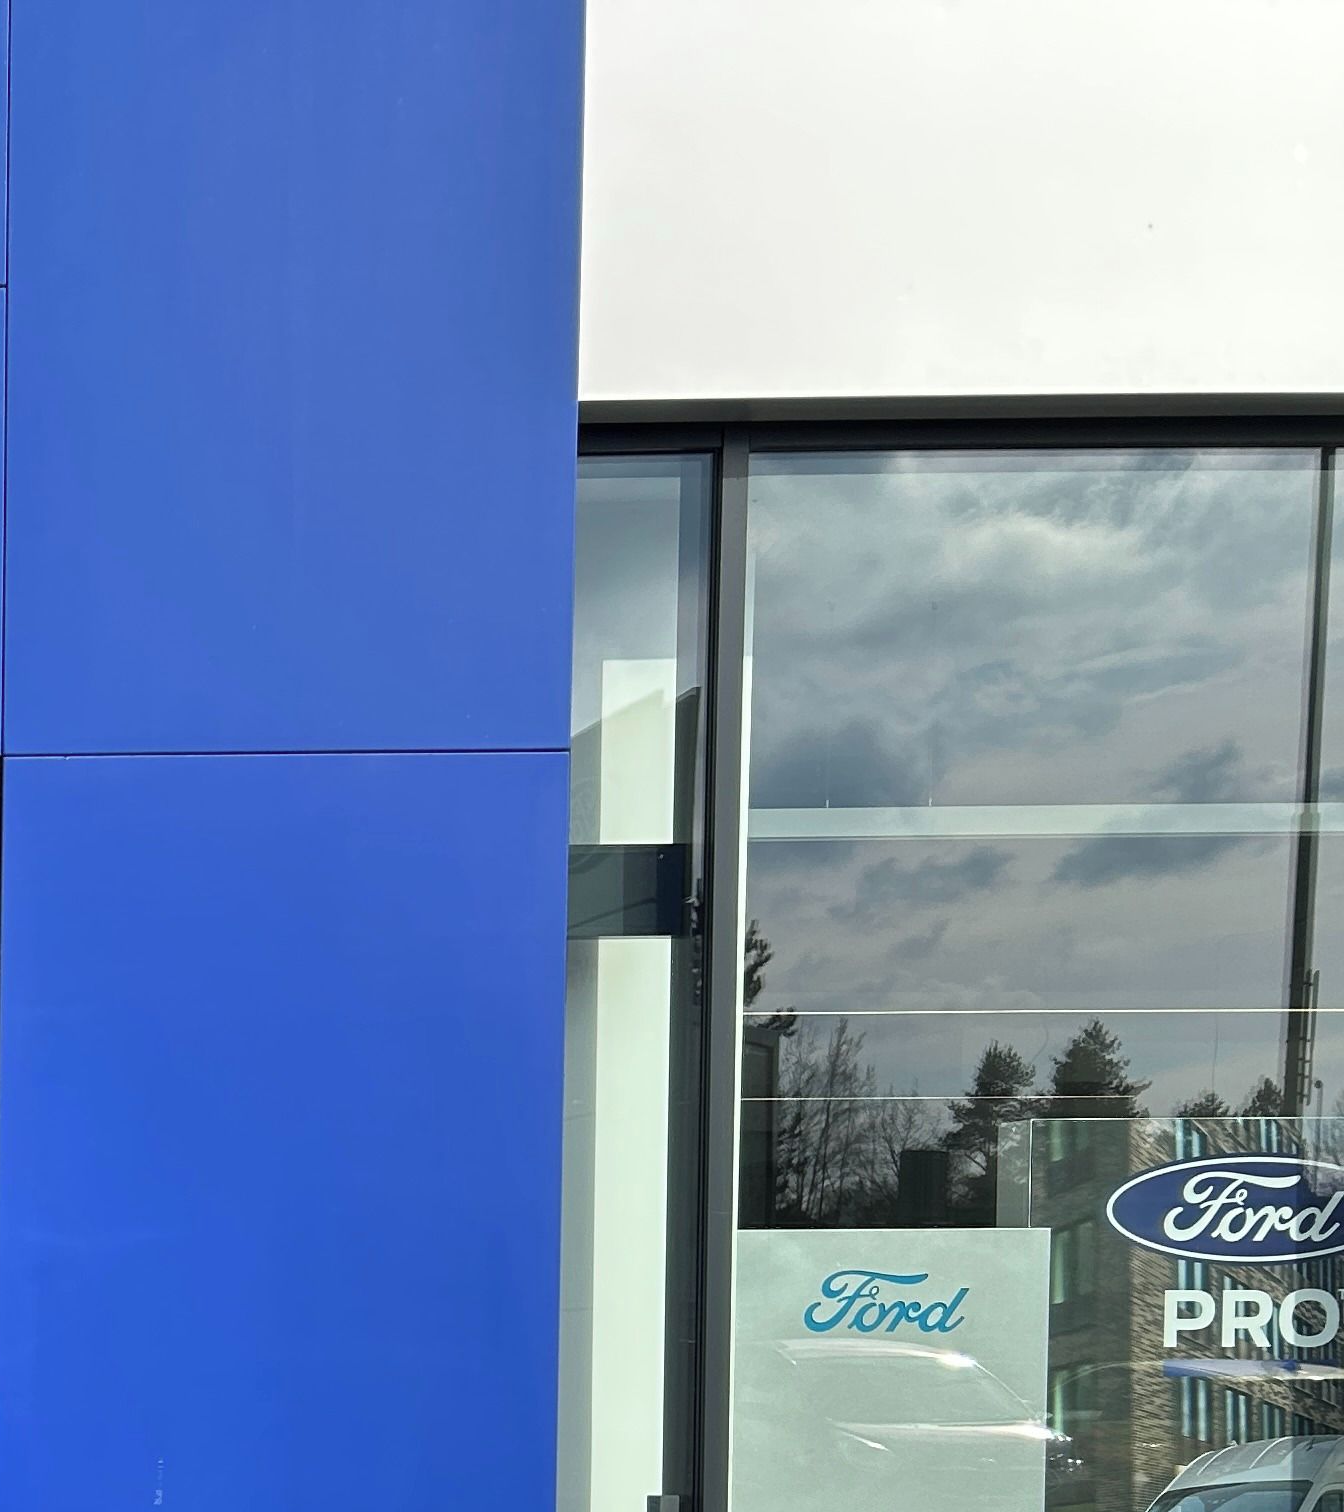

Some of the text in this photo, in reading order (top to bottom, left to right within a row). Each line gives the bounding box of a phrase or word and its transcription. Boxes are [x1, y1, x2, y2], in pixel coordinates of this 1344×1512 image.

[1163, 1170, 1344, 1243] Ford
[803, 1269, 970, 1333] Ford
[1162, 1288, 1341, 1348] PRO
